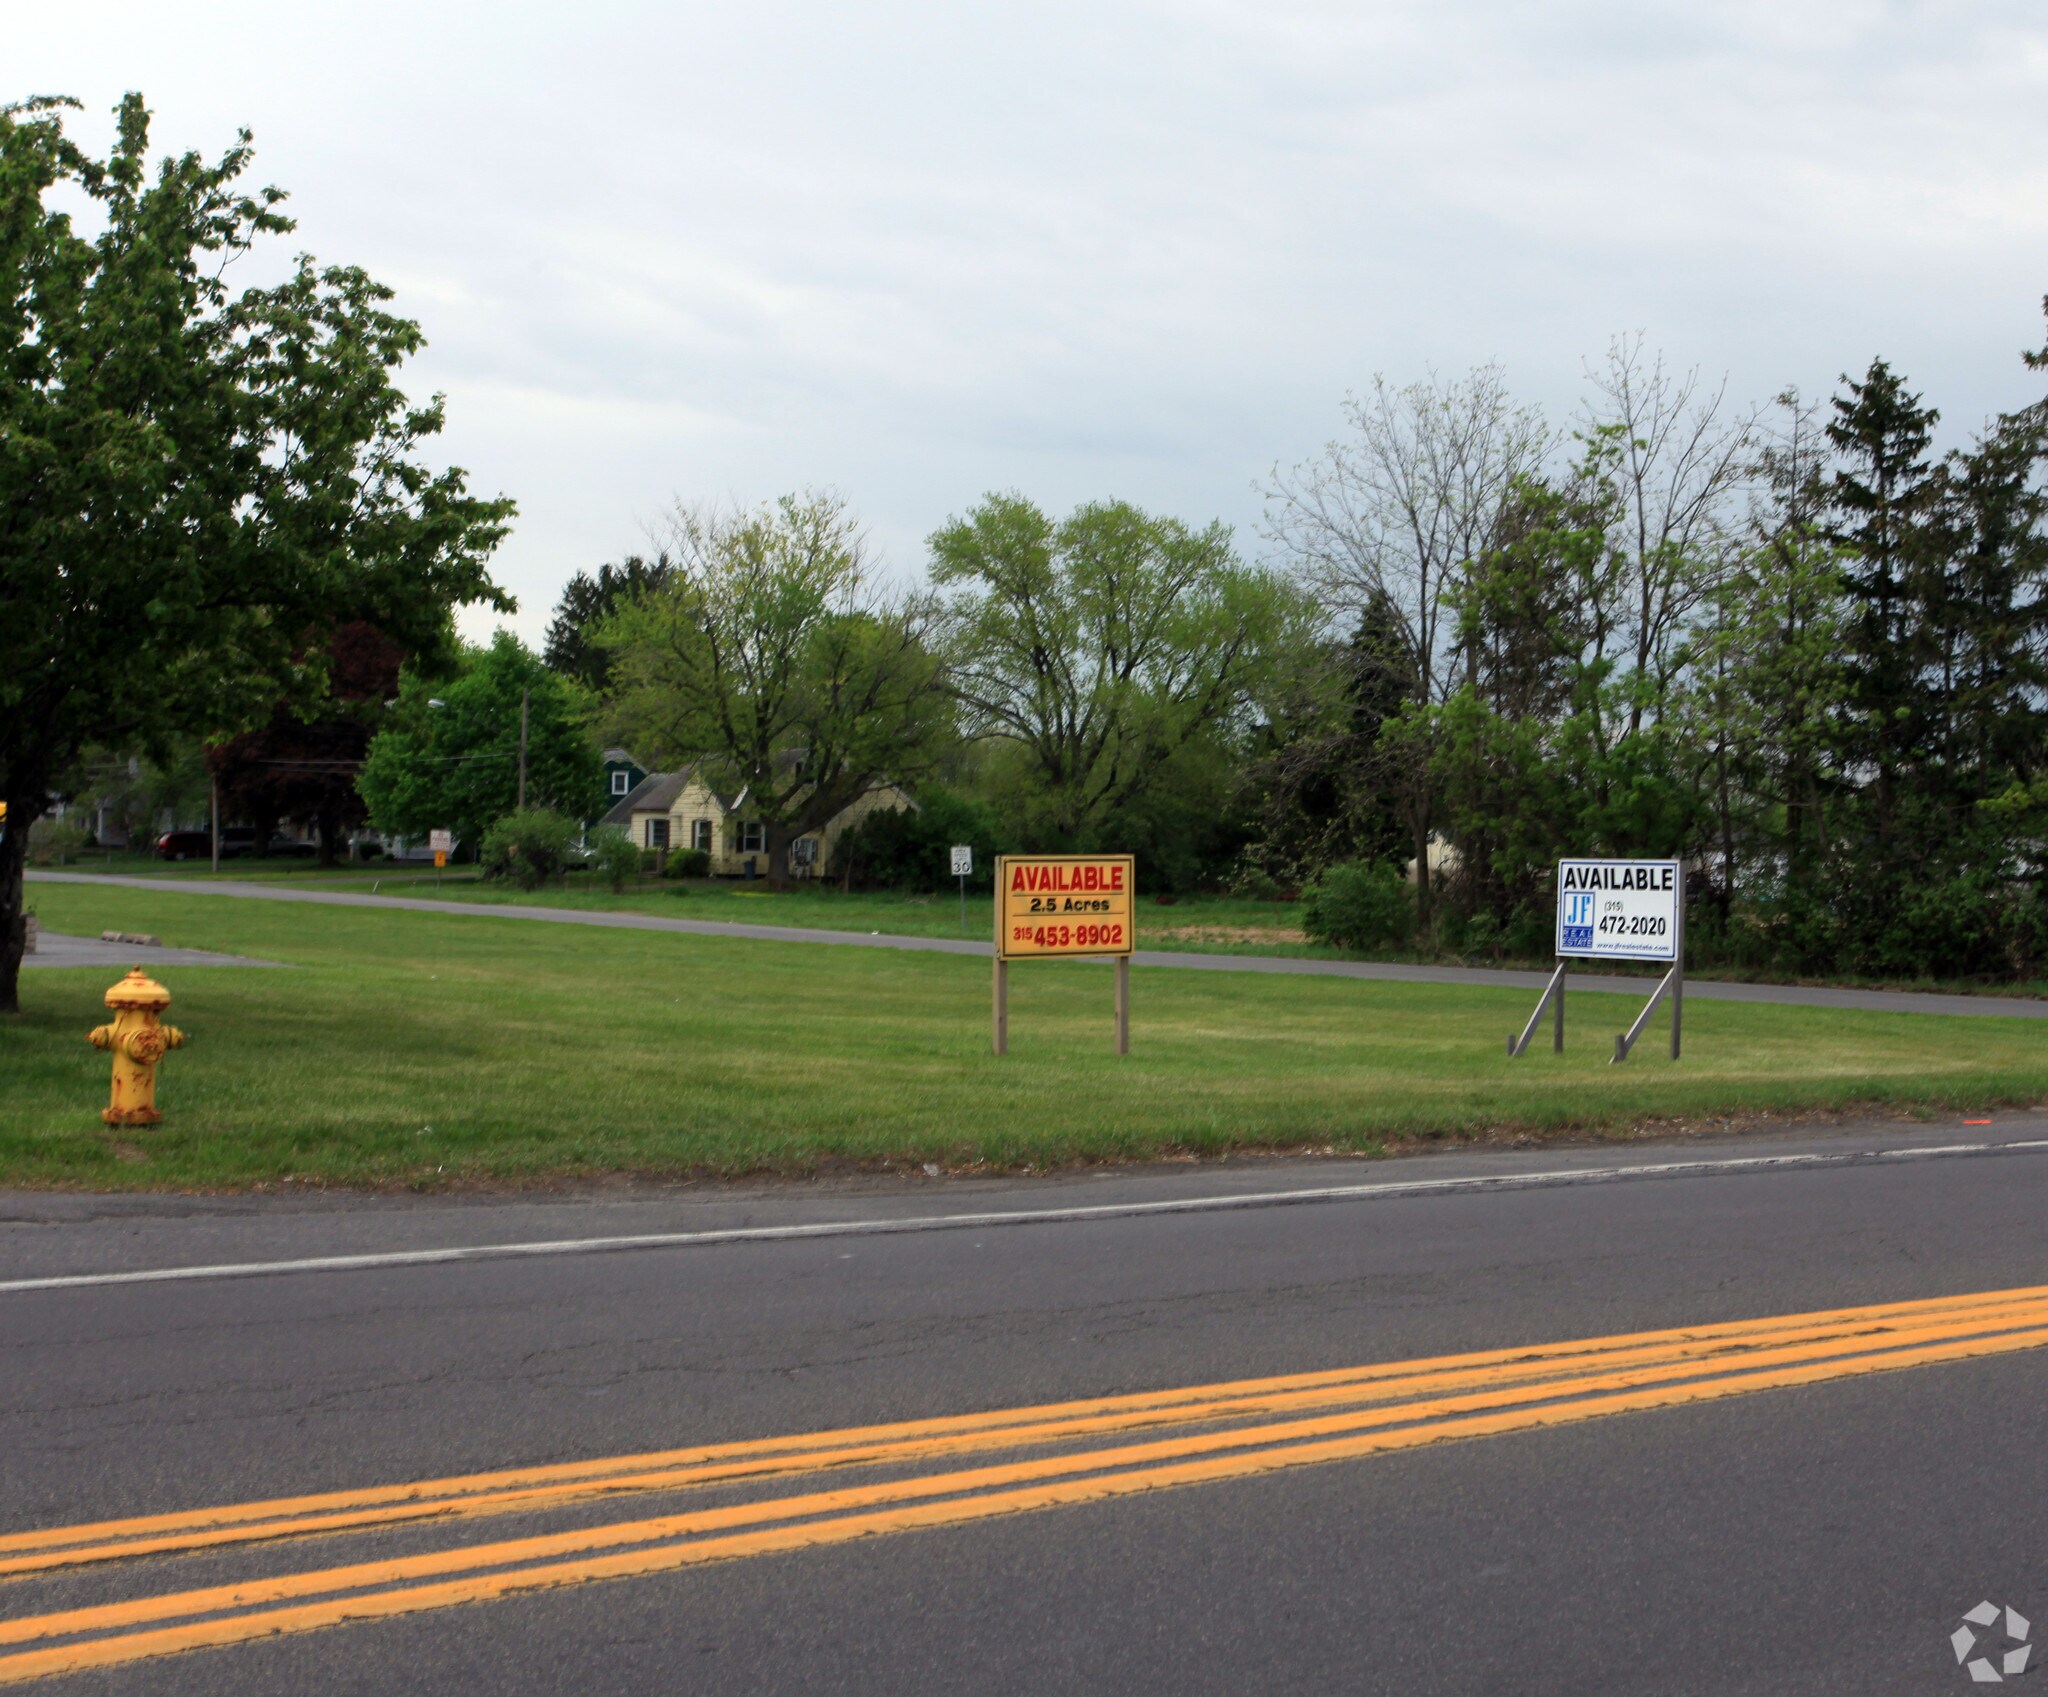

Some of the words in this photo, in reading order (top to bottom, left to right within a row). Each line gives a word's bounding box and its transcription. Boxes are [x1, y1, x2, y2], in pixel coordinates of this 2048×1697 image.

[953, 861, 970, 873] 30
[1011, 865, 1124, 892] AVAILABLE
[1563, 867, 1673, 891] AVAILABLE
[1030, 898, 1057, 912] 2.5
[1063, 898, 1110, 911] Acres
[1604, 901, 1624, 914] (315)
[1599, 915, 1666, 936] 472-2020
[1013, 927, 1033, 941] 315
[1034, 924, 1122, 947] 453-8902
[1563, 929, 1592, 938] REAL
[1562, 938, 1593, 947] ESTATE
